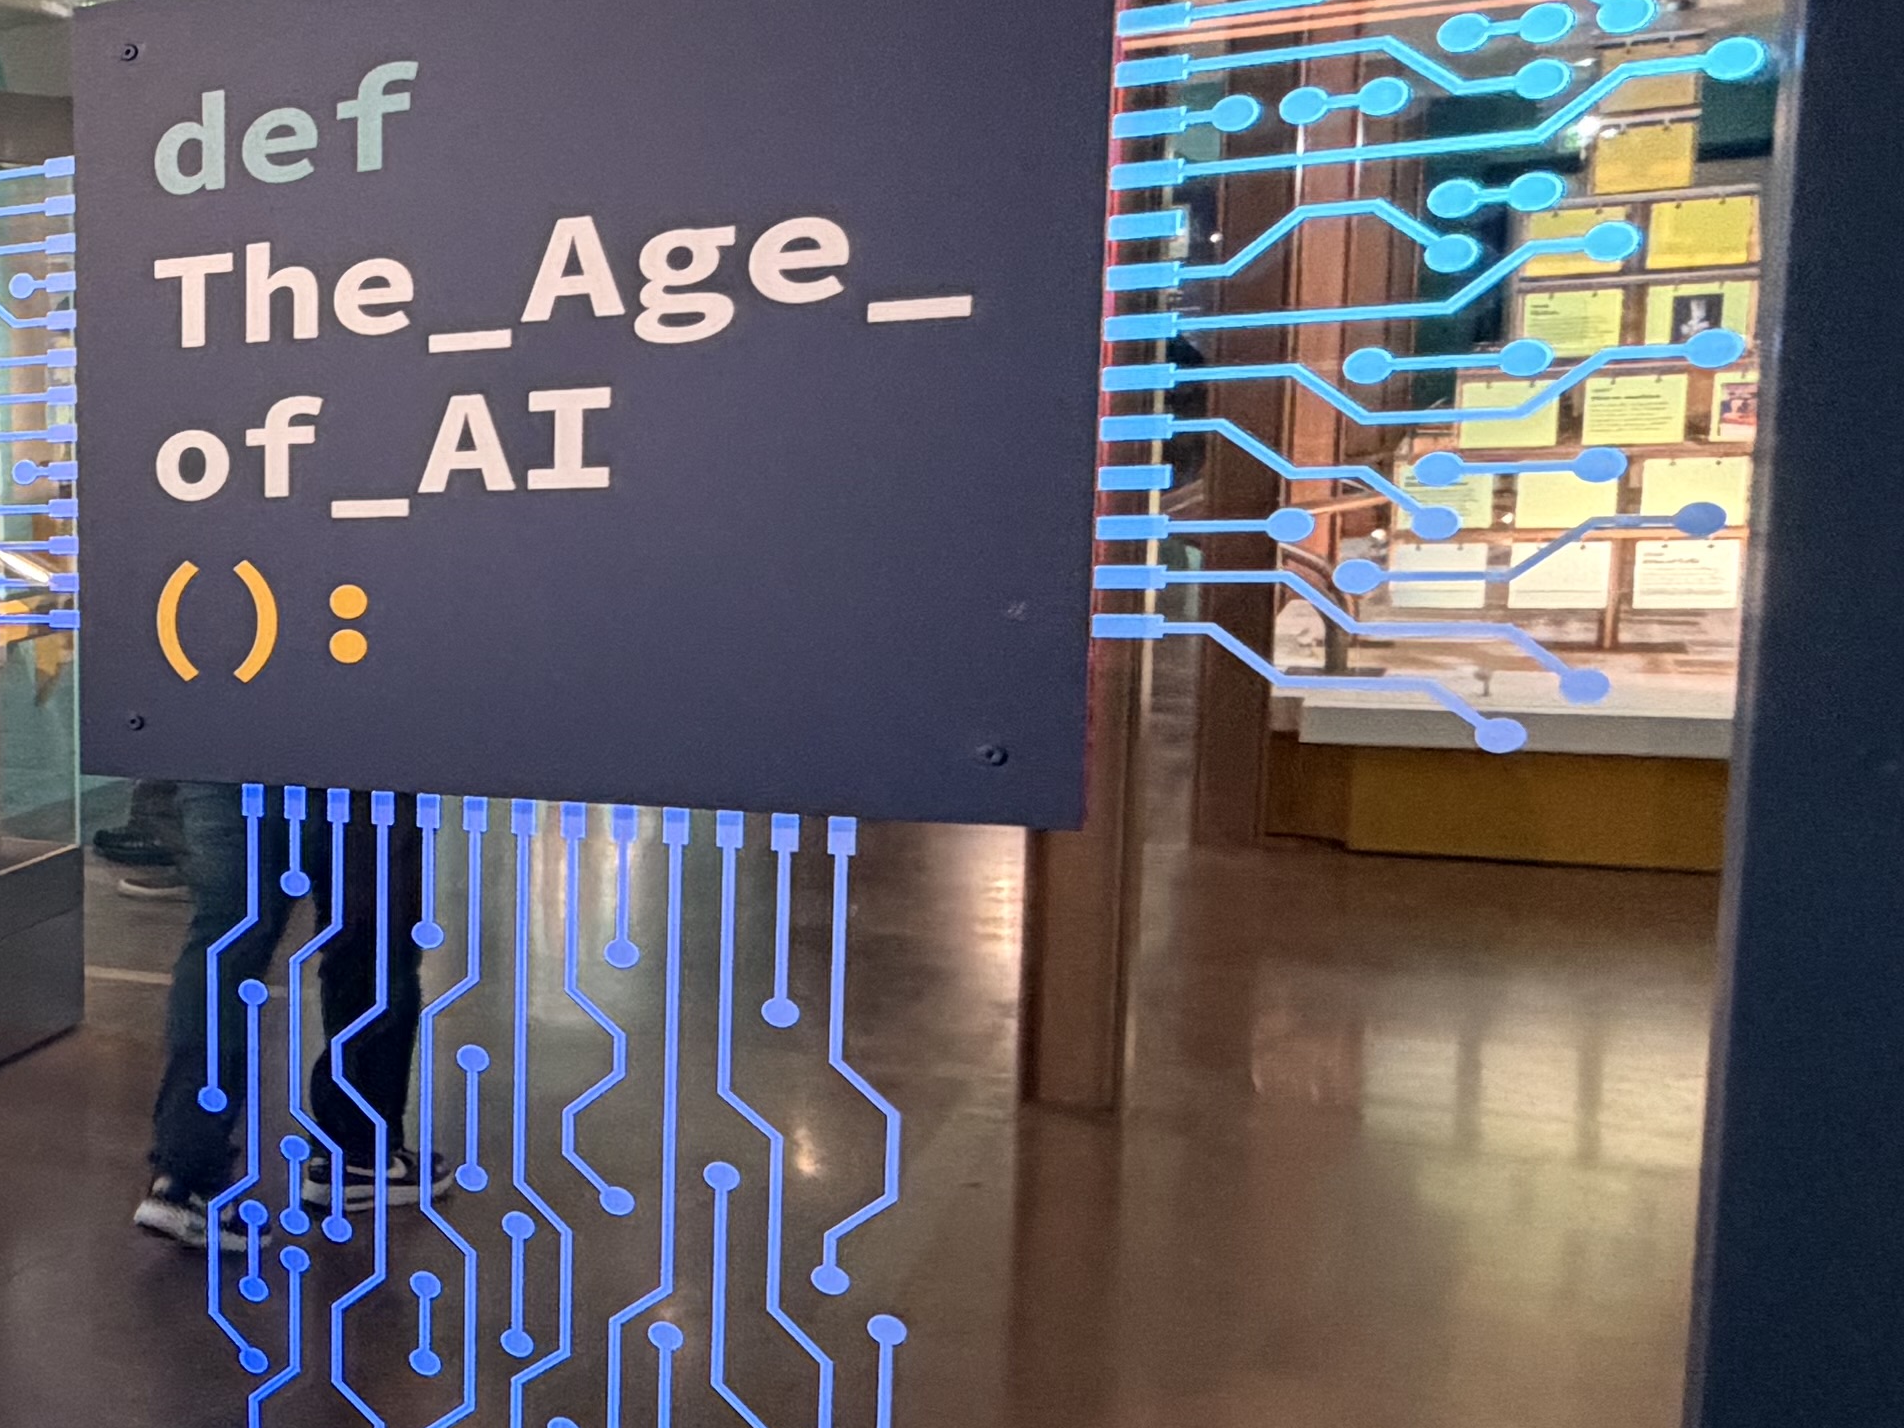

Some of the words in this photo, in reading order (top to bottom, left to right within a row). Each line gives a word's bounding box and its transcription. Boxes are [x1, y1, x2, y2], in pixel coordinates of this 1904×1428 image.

[154, 61, 419, 195] def
[154, 215, 973, 353] The_Age_
[154, 386, 612, 518] of_AI
